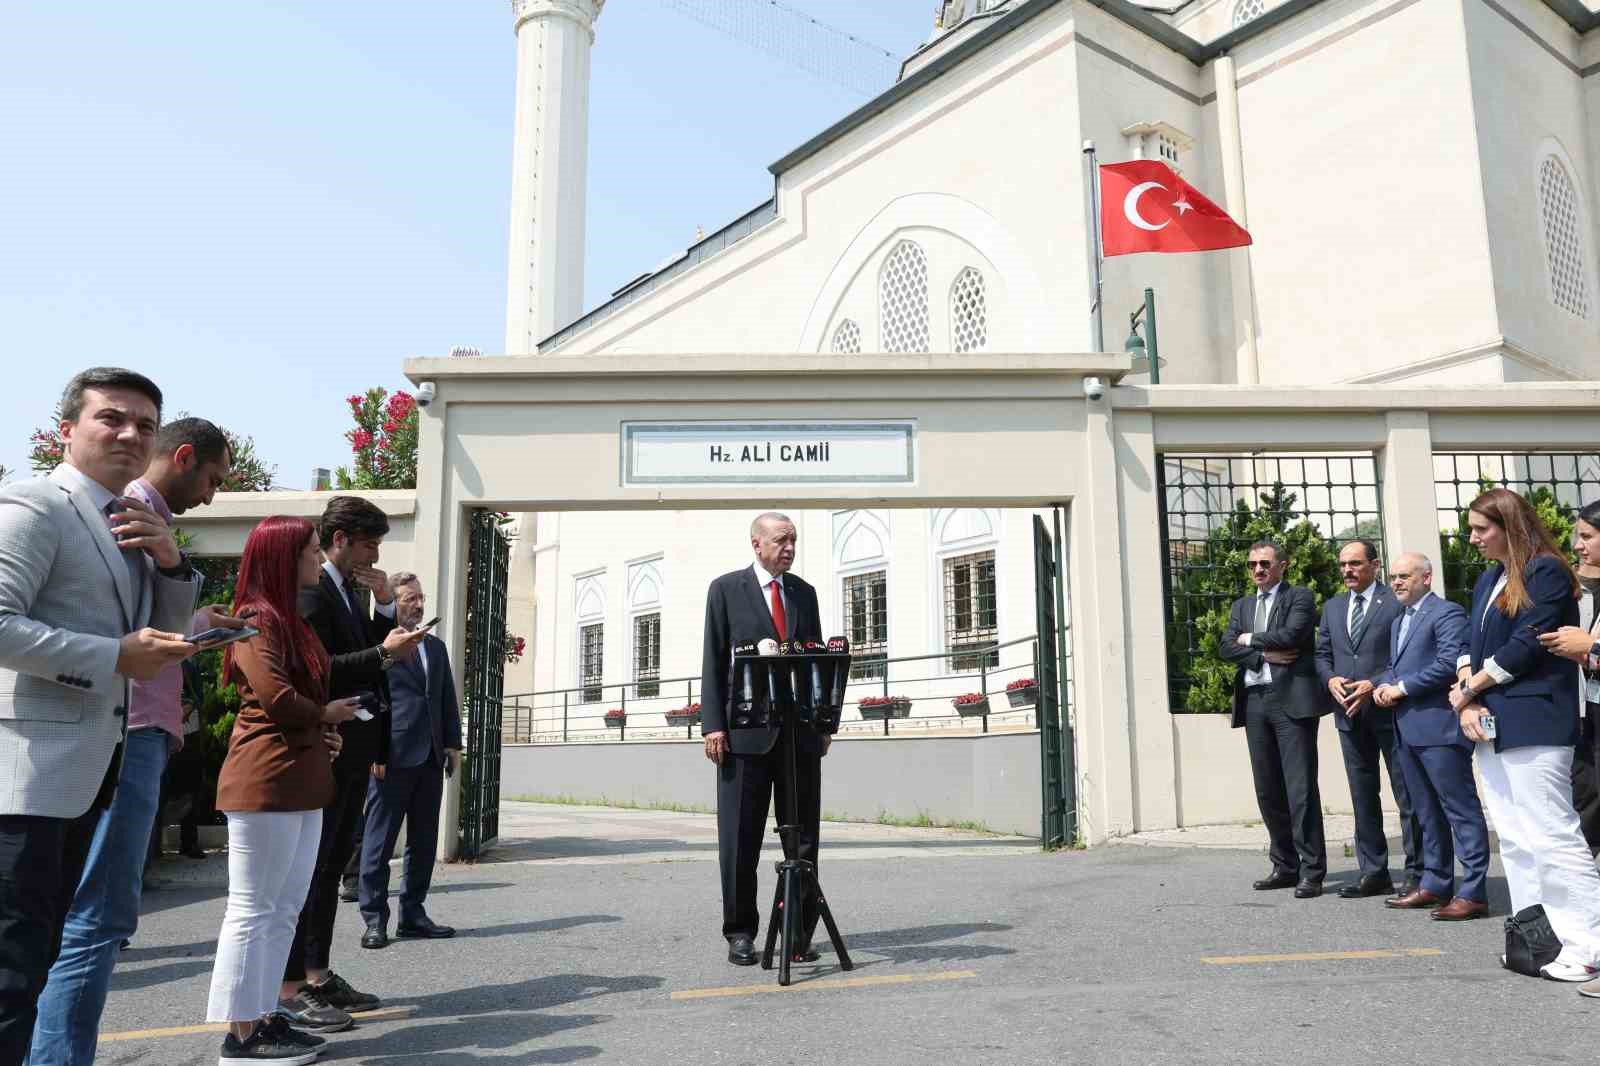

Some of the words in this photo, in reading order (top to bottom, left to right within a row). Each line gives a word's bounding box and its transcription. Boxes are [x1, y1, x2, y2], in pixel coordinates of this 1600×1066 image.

[710, 445, 734, 462] Hz.
[741, 442, 771, 462] ALİ
[780, 442, 829, 462] CAMİİ
[829, 640, 844, 648] CNN
